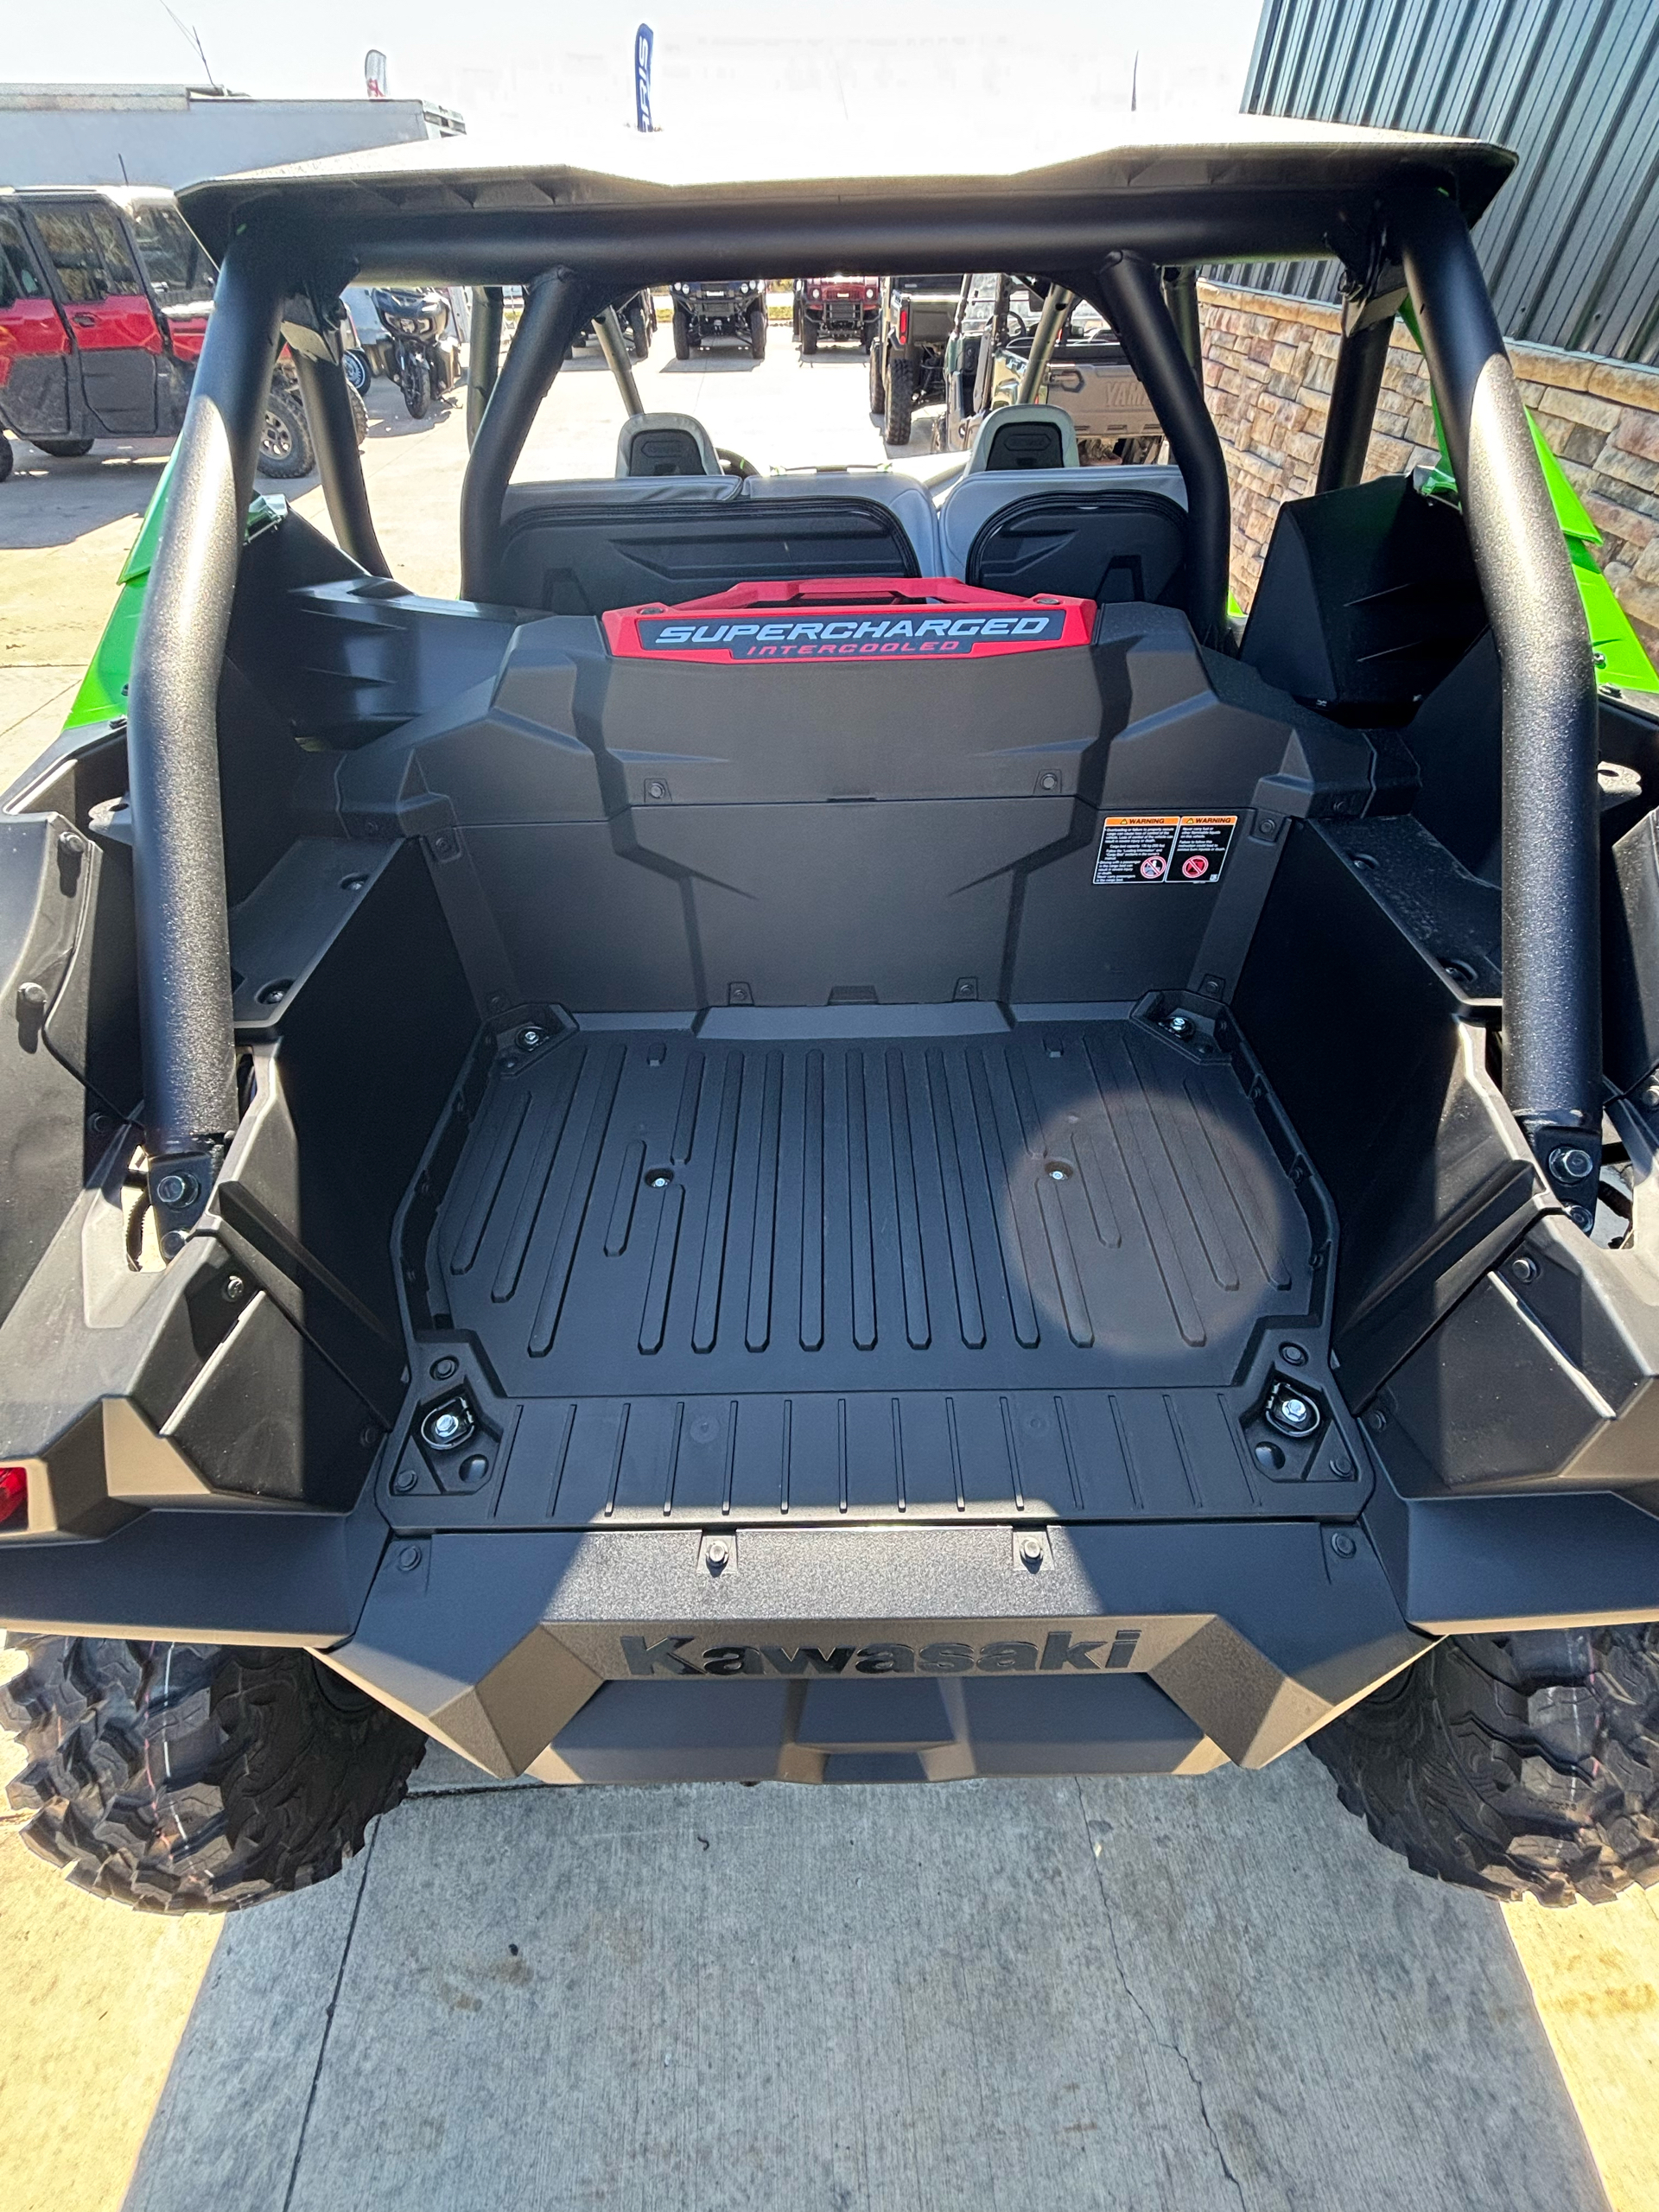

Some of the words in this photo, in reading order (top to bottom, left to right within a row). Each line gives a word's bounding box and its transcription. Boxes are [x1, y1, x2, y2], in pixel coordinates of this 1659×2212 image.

[1105, 382, 1150, 406] YAM
[655, 617, 1049, 644] SUPERCHARGED
[747, 641, 959, 656] INTERCOOLED
[619, 1630, 1142, 1675] Kawasaki
